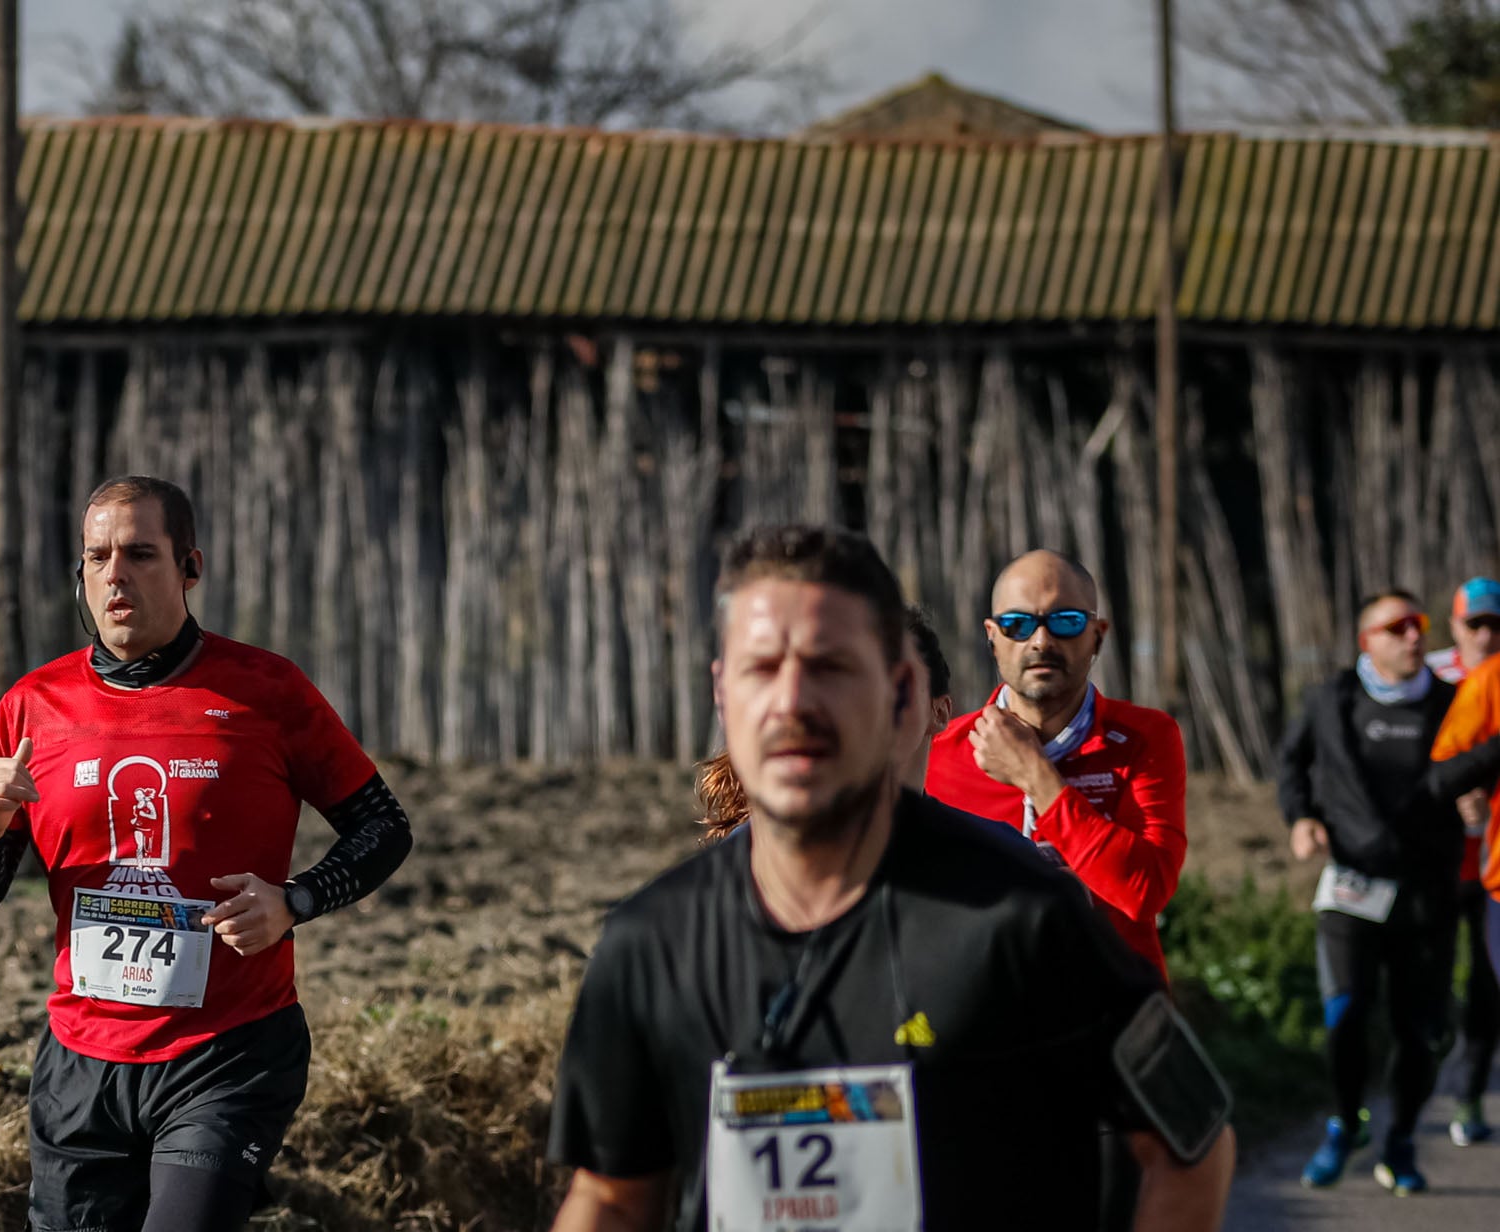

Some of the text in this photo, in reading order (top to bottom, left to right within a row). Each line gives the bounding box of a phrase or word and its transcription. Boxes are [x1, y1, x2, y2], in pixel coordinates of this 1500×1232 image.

[168, 759, 179, 778] 37
[179, 768, 219, 778] GRANADA
[106, 866, 173, 883] MMCG
[111, 898, 160, 910] CARRERA
[111, 907, 159, 917] POPULAR
[102, 926, 176, 966] 274
[122, 966, 154, 982] ARIAS
[132, 985, 157, 994] olimpo
[752, 1133, 837, 1191] 12
